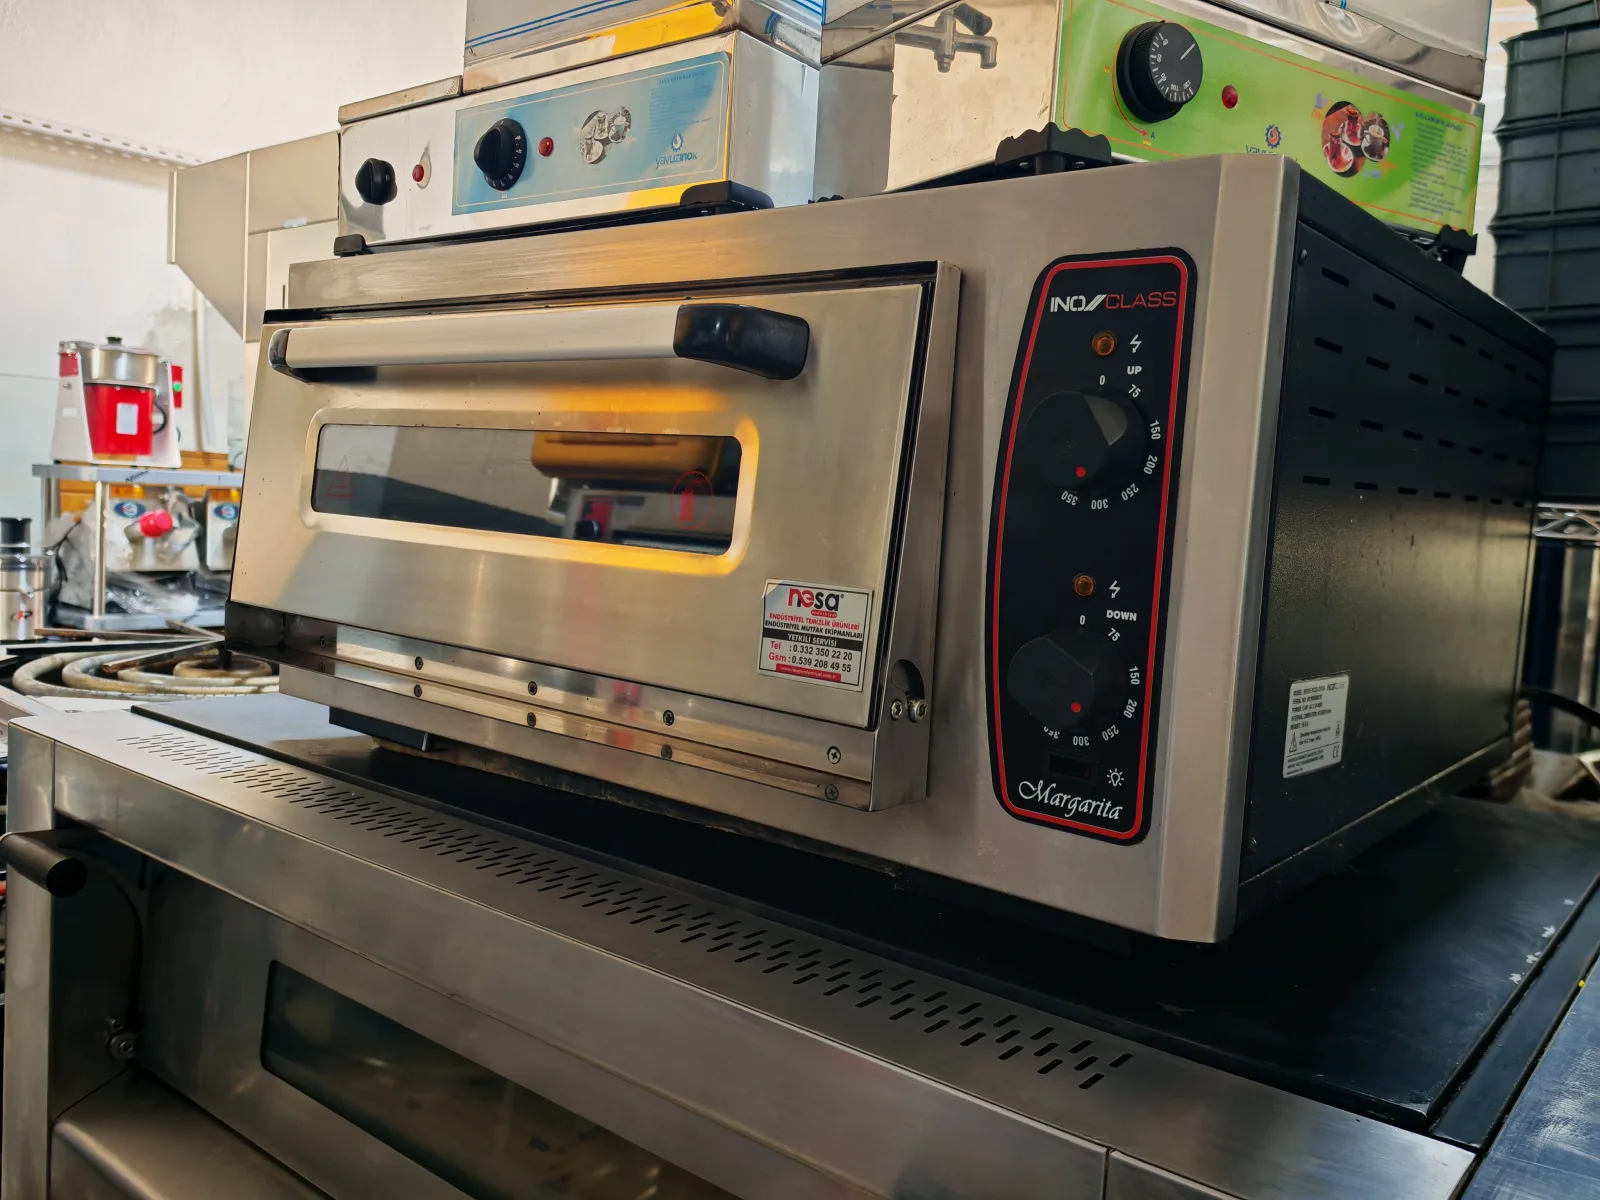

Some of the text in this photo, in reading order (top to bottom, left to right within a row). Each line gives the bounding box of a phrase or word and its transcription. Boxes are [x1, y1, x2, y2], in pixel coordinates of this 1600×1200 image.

[655, 151, 698, 170] yavuzinox
[1127, 366, 1142, 375] UP
[1099, 374, 1106, 386] 0
[1128, 384, 1141, 398] 75
[1149, 420, 1161, 440] 150
[1143, 455, 1158, 475] 200
[1061, 491, 1078, 506] 350
[1121, 483, 1139, 501] 250
[1091, 499, 1108, 510] 300
[787, 588, 840, 612] nesa
[1079, 615, 1086, 626] 0
[1106, 610, 1137, 621] DOWN
[801, 624, 823, 634] MUTFAK
[1107, 627, 1120, 641] 75
[770, 640, 781, 650] Tel
[815, 647, 829, 658] 350
[832, 650, 841, 659] 22
[843, 652, 853, 661] 20
[768, 652, 786, 662] Gsm
[814, 659, 828, 669] 208
[830, 661, 840, 671] 49
[841, 663, 851, 673] 55
[1129, 665, 1140, 685] 150
[1123, 699, 1137, 719] 200
[1072, 736, 1090, 746] 300
[1102, 725, 1119, 741] 250
[1018, 779, 1123, 820] Margarita
